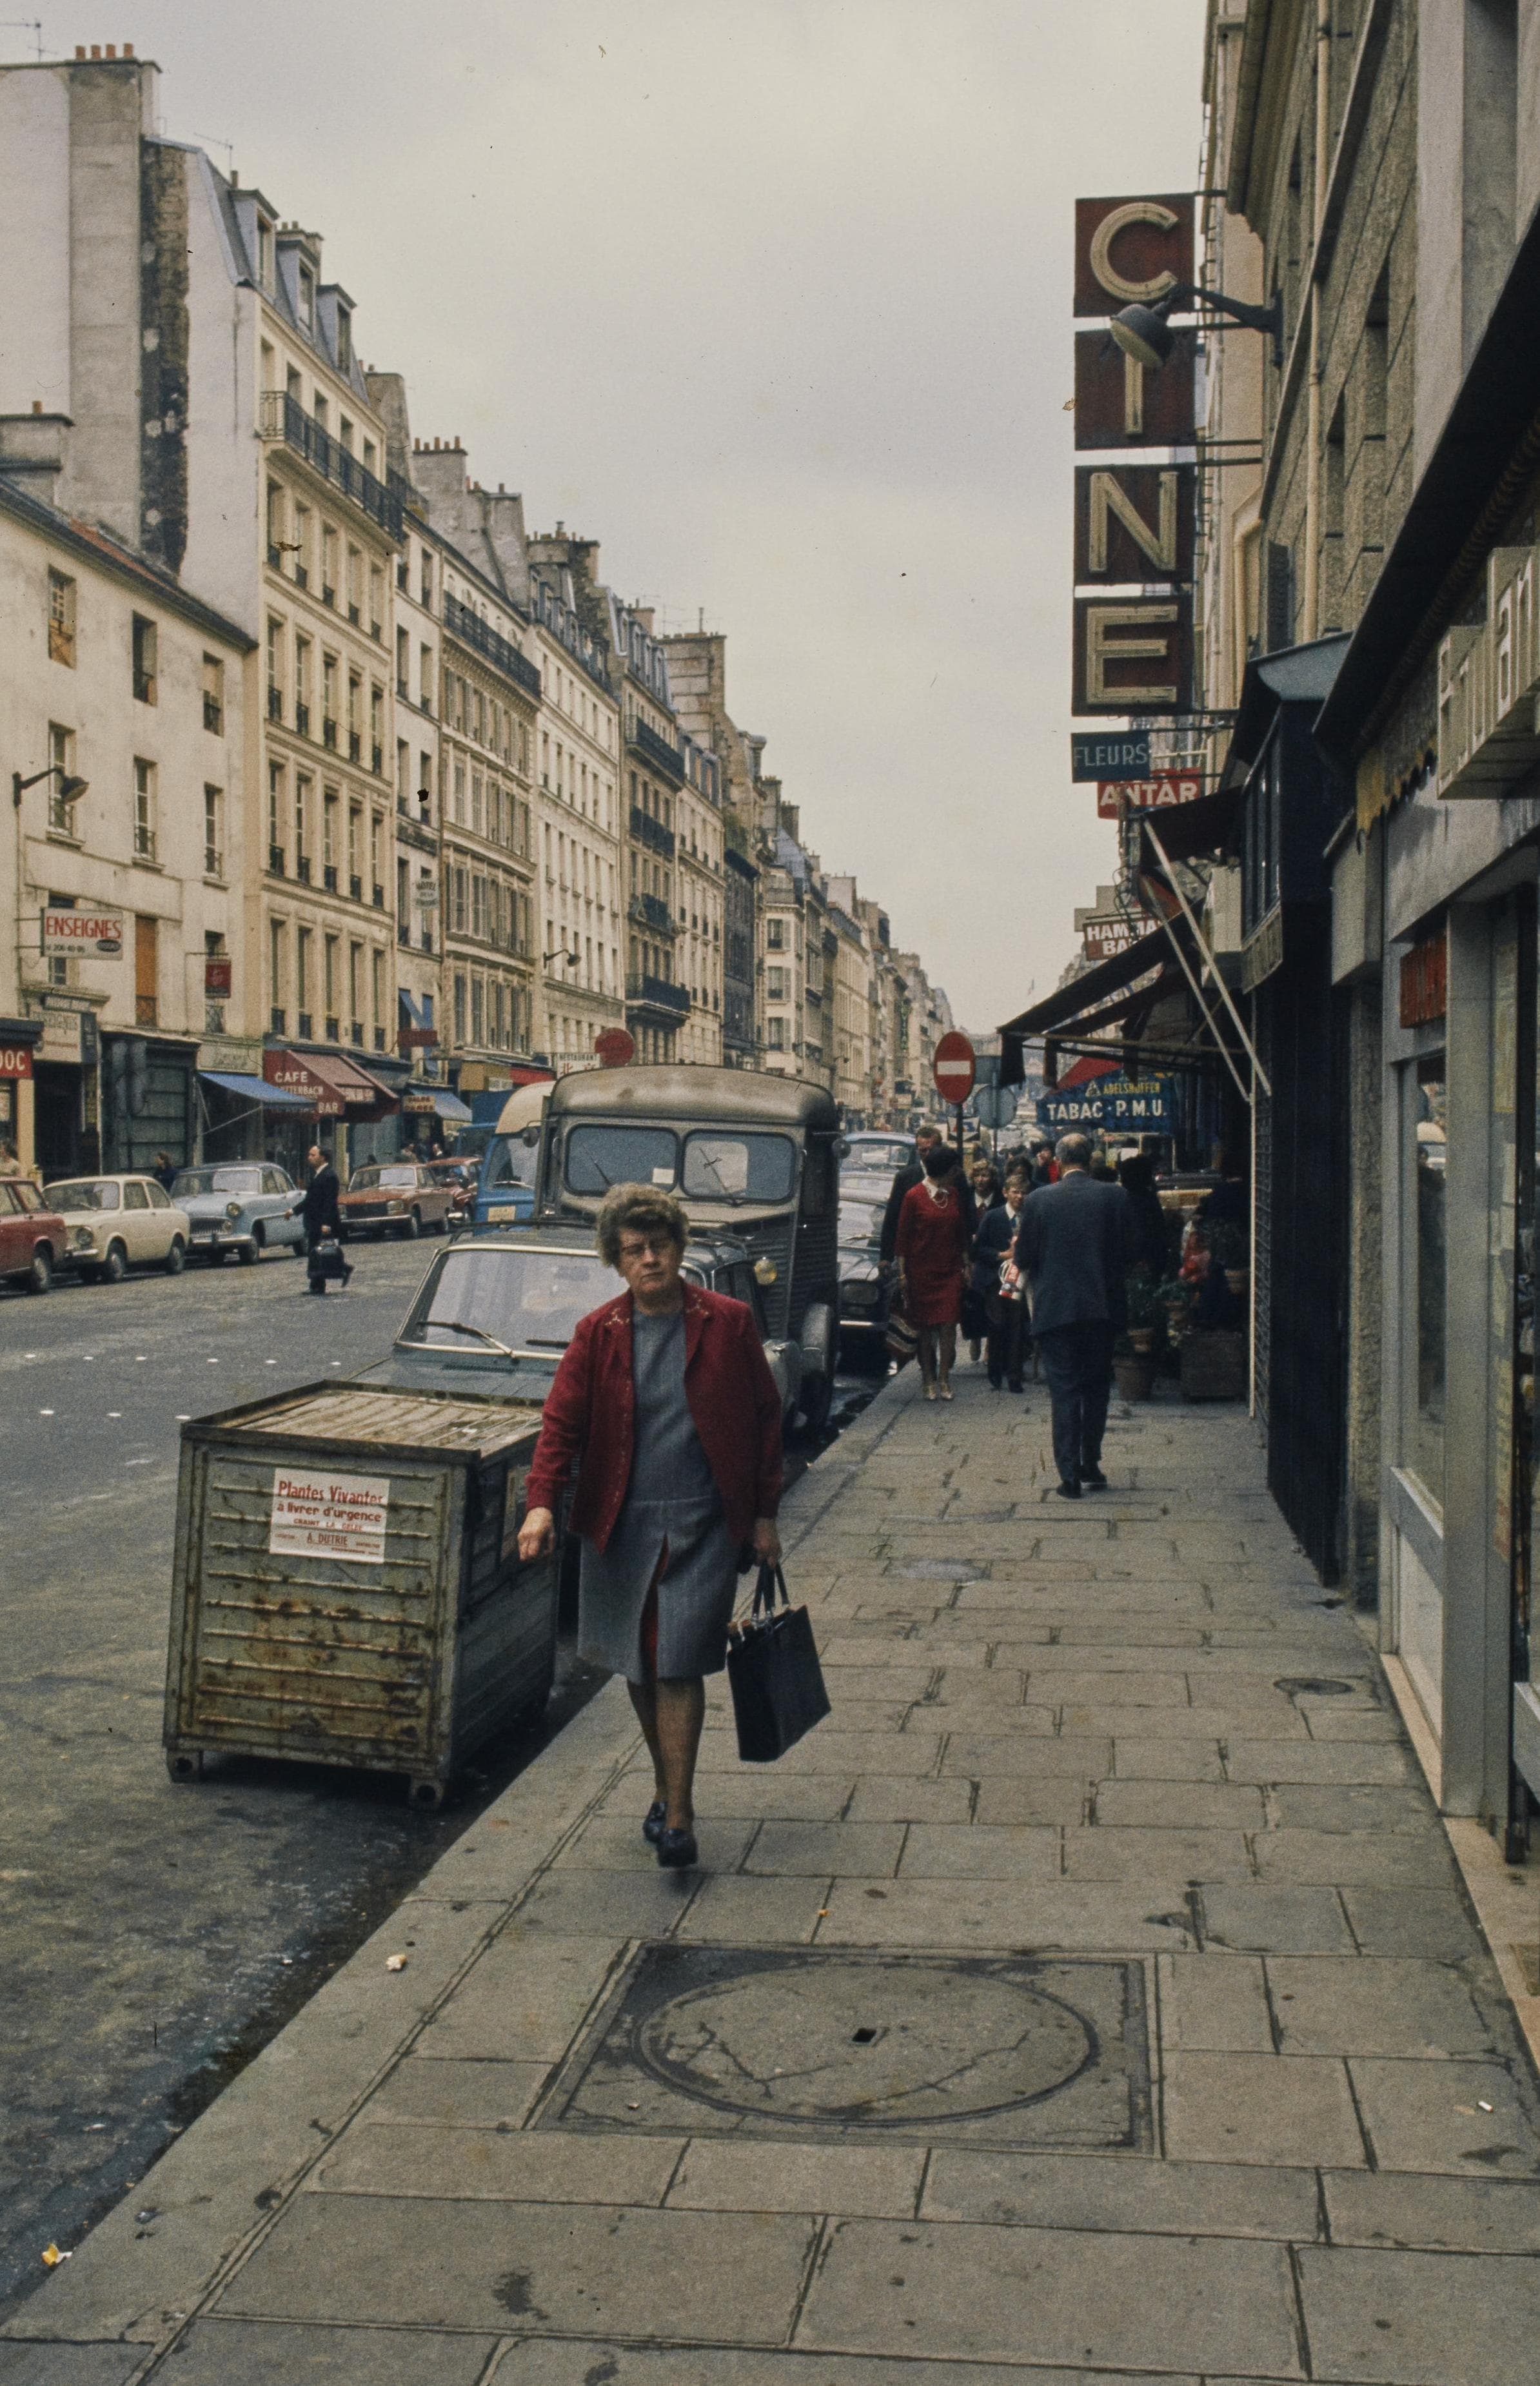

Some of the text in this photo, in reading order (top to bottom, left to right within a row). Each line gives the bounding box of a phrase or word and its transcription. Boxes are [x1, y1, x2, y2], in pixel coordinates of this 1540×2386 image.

[1086, 202, 1179, 705] CINE
[1073, 744, 1149, 766] FLEURS
[1100, 782, 1198, 806] ANTAR
[45, 916, 121, 939] ENSEIGNES
[1087, 919, 1161, 942] HAMMA
[559, 1052, 597, 1061] RESTAURANT
[275, 1071, 308, 1083] CAFE
[318, 1102, 339, 1114] BAR
[1047, 1099, 1167, 1121] TABAC P.M.U.
[277, 1480, 324, 1501] Plantes
[287, 1501, 320, 1515] livrer
[323, 1506, 382, 1523] d'urgence
[319, 1533, 348, 1546] DUTRIE
